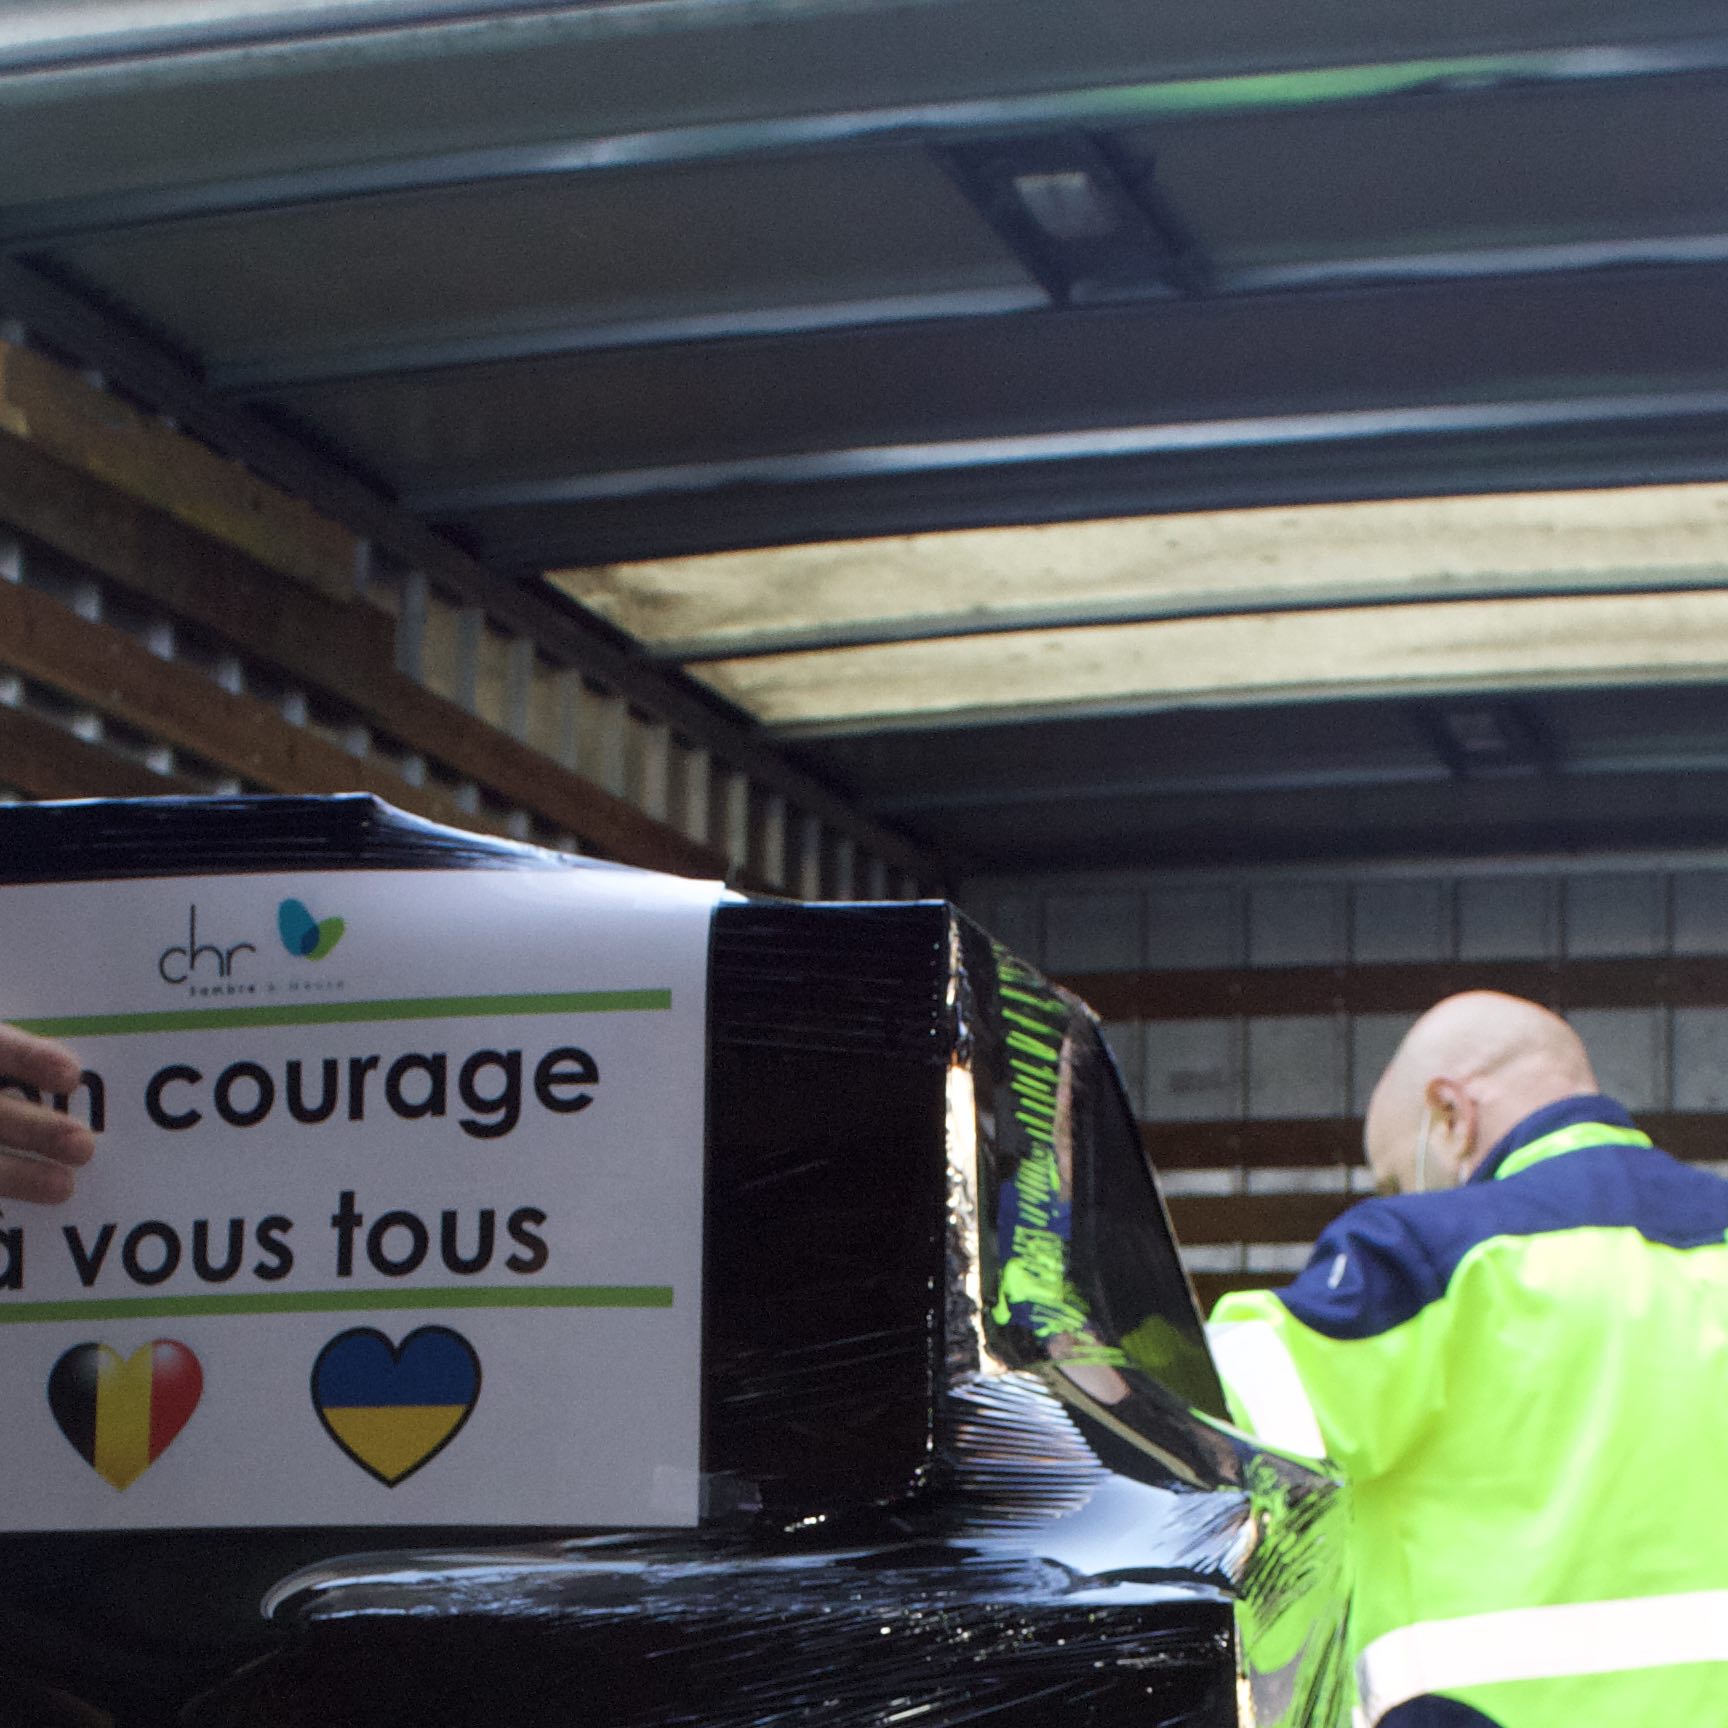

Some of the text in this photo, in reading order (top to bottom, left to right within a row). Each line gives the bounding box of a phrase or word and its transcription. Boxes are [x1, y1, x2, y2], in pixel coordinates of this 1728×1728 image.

[158, 904, 257, 985] chr
[145, 1046, 600, 1139] courage
[61, 1214, 294, 1289] vous
[331, 1190, 549, 1278] tous
